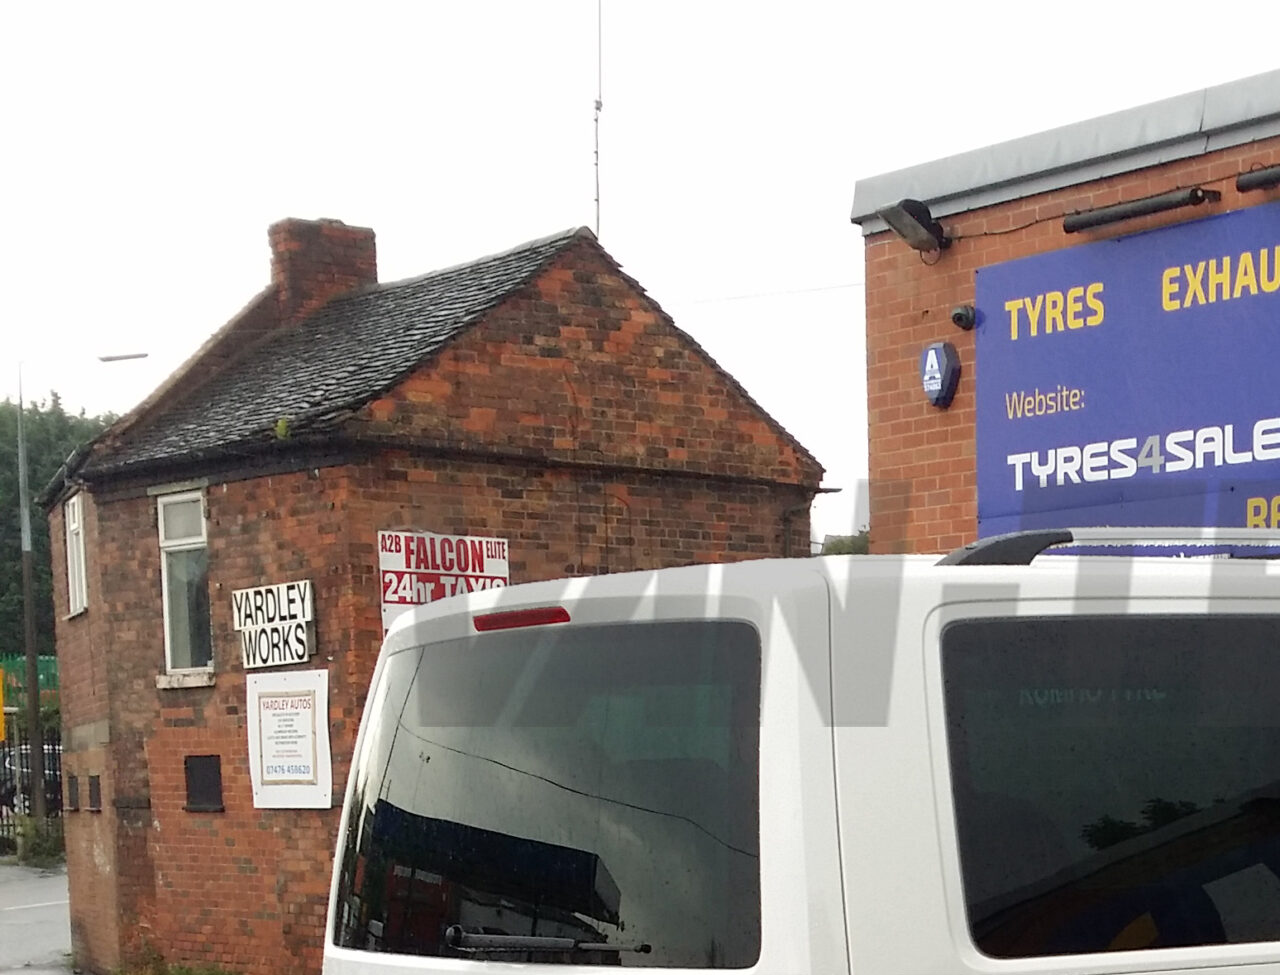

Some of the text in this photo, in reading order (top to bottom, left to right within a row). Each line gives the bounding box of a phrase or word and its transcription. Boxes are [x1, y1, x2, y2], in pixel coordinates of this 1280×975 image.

[1004, 281, 1105, 341] TYRES
[1005, 388, 1085, 420] Website:
[381, 534, 506, 573] A2B FALCON ELITE
[233, 581, 308, 627] YARDLEY
[384, 573, 435, 603] 24hr
[243, 623, 306, 666] WORKS
[262, 698, 312, 711] YARDLEY AUTOS
